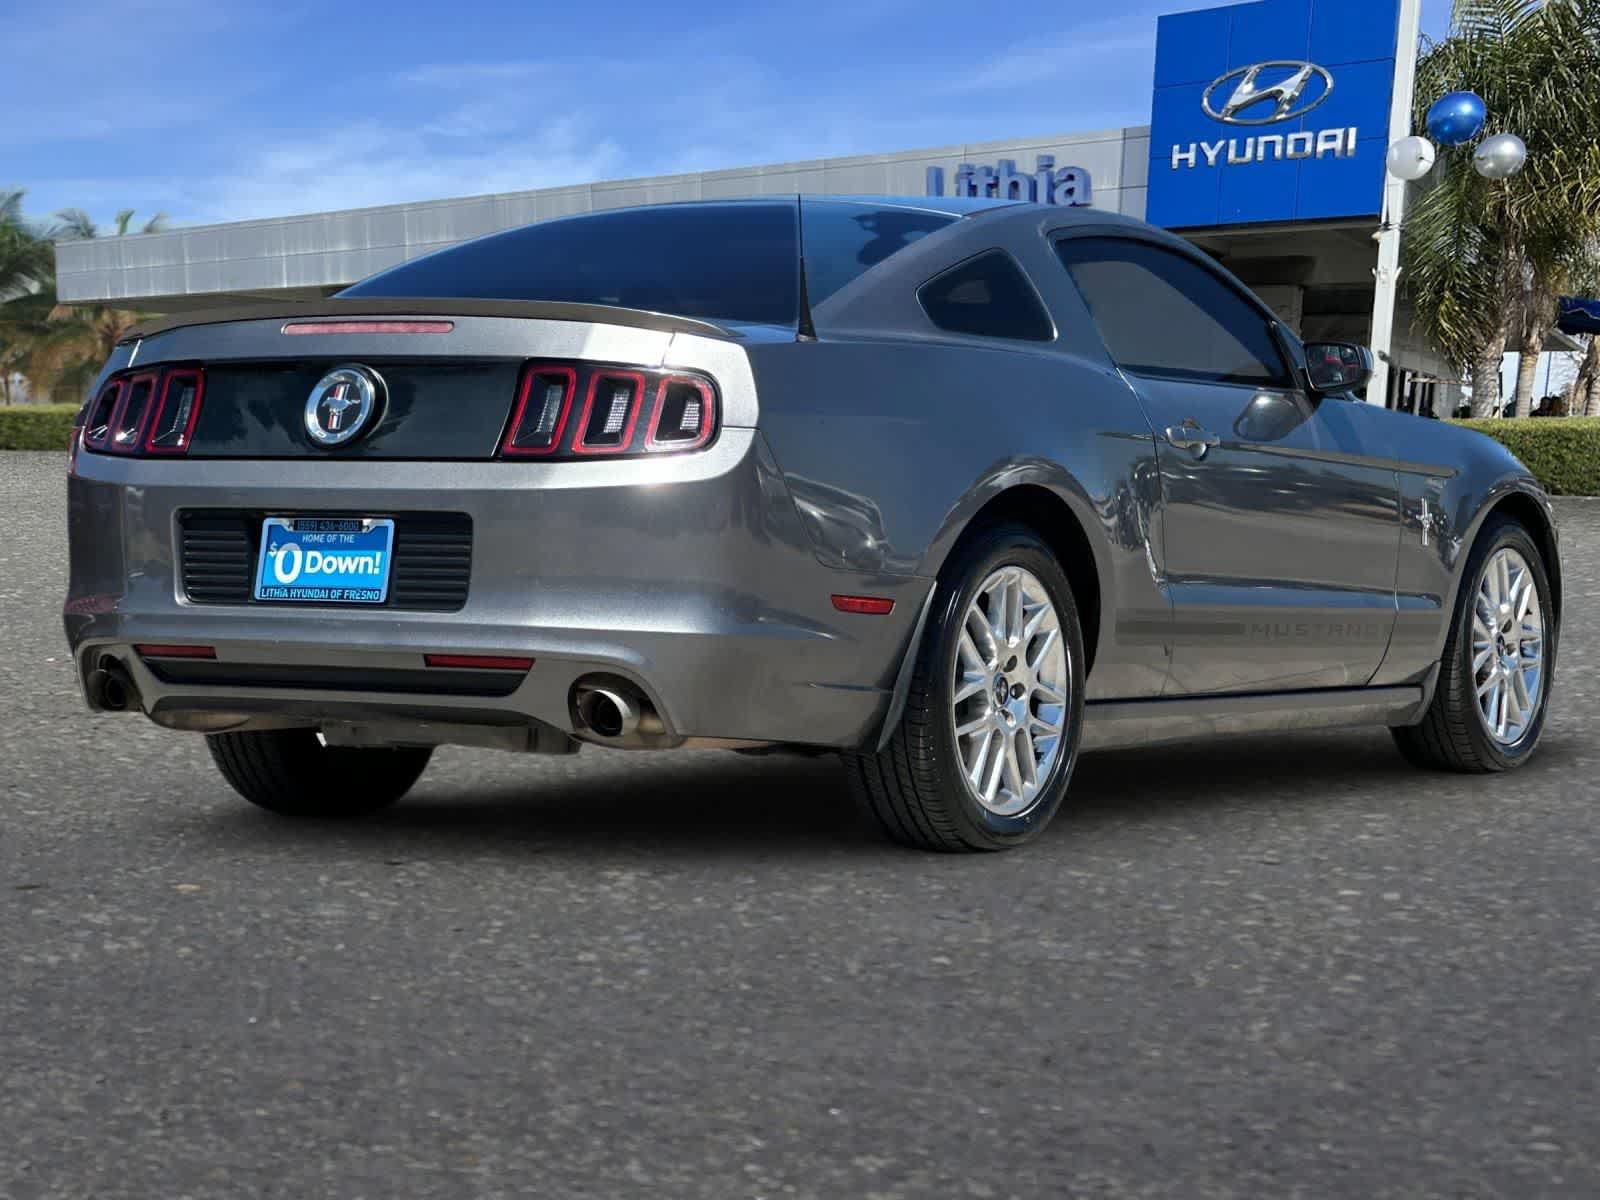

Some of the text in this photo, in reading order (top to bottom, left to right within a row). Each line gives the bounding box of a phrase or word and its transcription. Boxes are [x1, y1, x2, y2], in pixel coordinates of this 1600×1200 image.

[1171, 127, 1358, 169] HYUNDAI
[302, 534, 355, 543] HOME OF THE
[304, 551, 382, 575] Down!
[290, 588, 329, 599] HYUNDAI
[330, 589, 343, 599] OF
